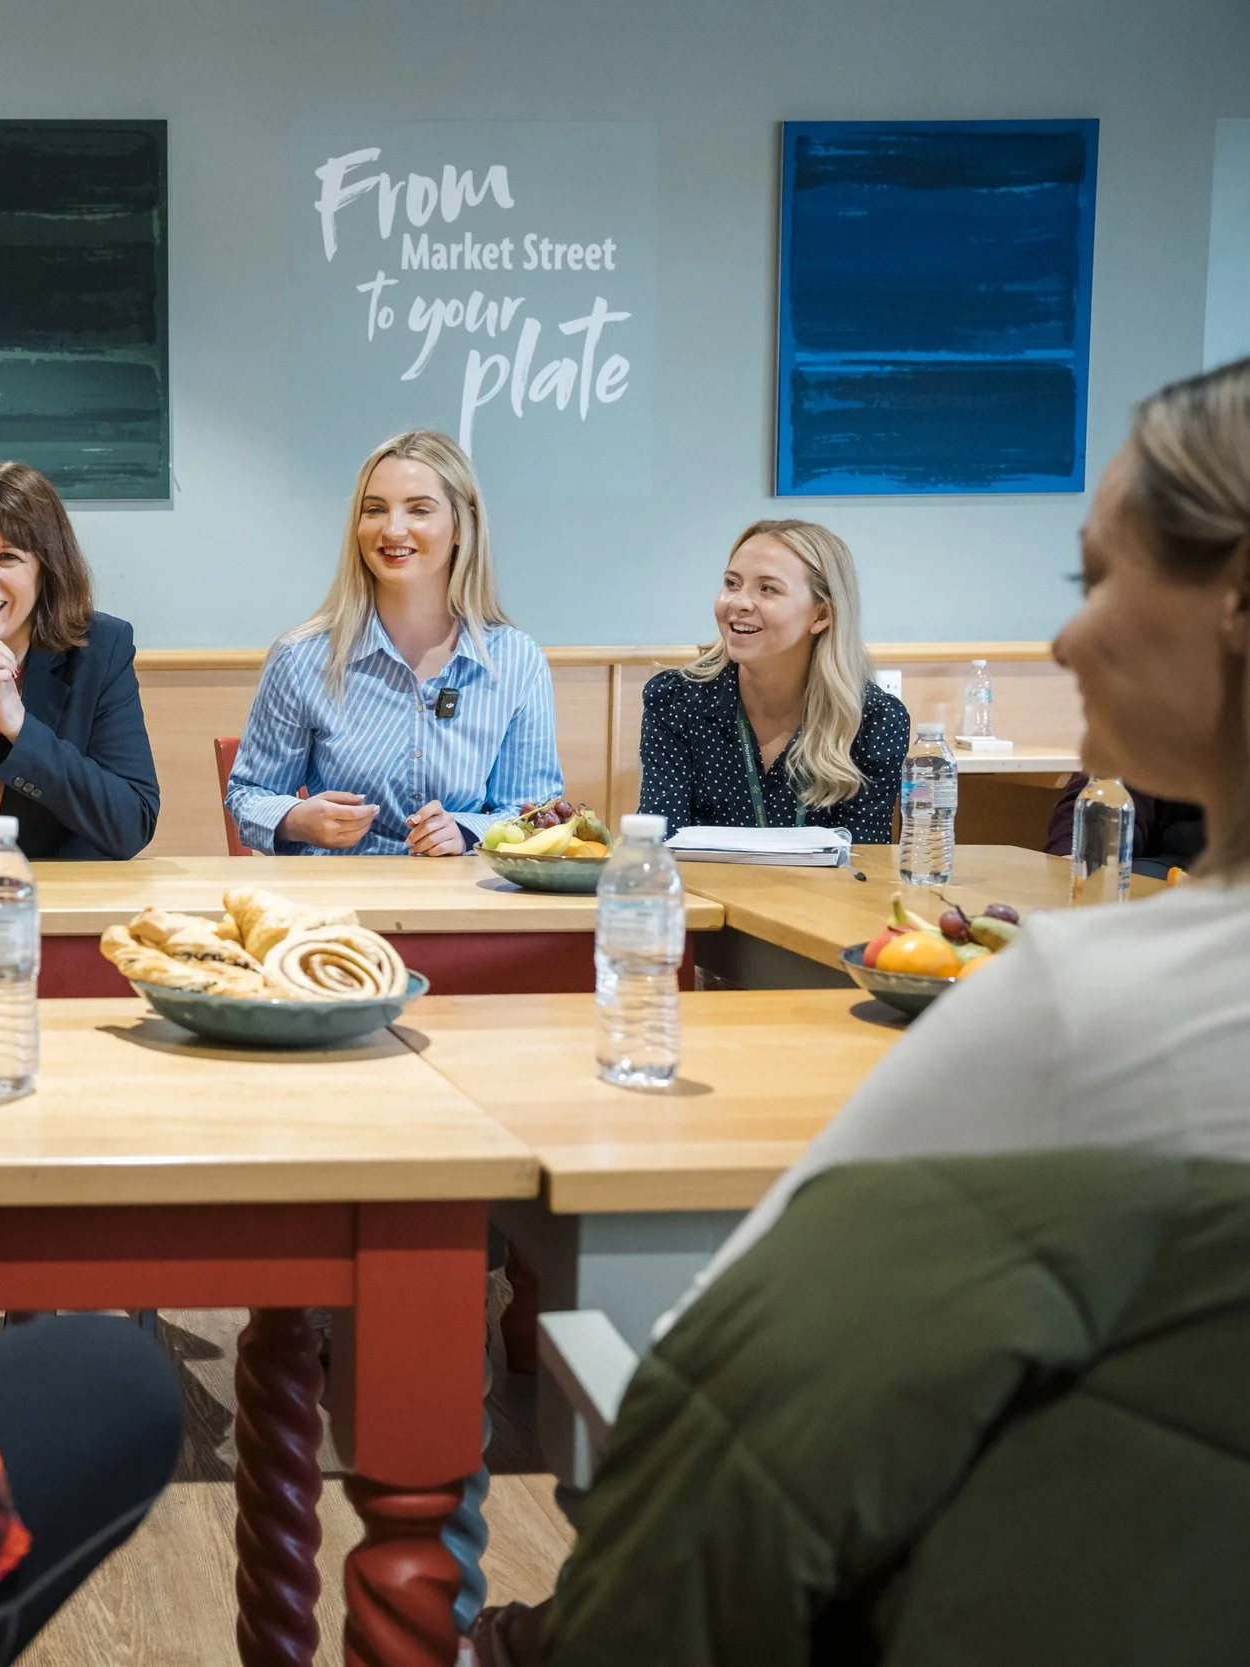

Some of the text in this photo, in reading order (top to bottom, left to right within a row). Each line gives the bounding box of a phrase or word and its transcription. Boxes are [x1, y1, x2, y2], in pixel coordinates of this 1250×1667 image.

[314, 146, 515, 262] From
[401, 232, 617, 271] Market Street
[400, 290, 527, 382] your
[459, 296, 632, 460] plate
[743, 743, 754, 773] Morrisons
